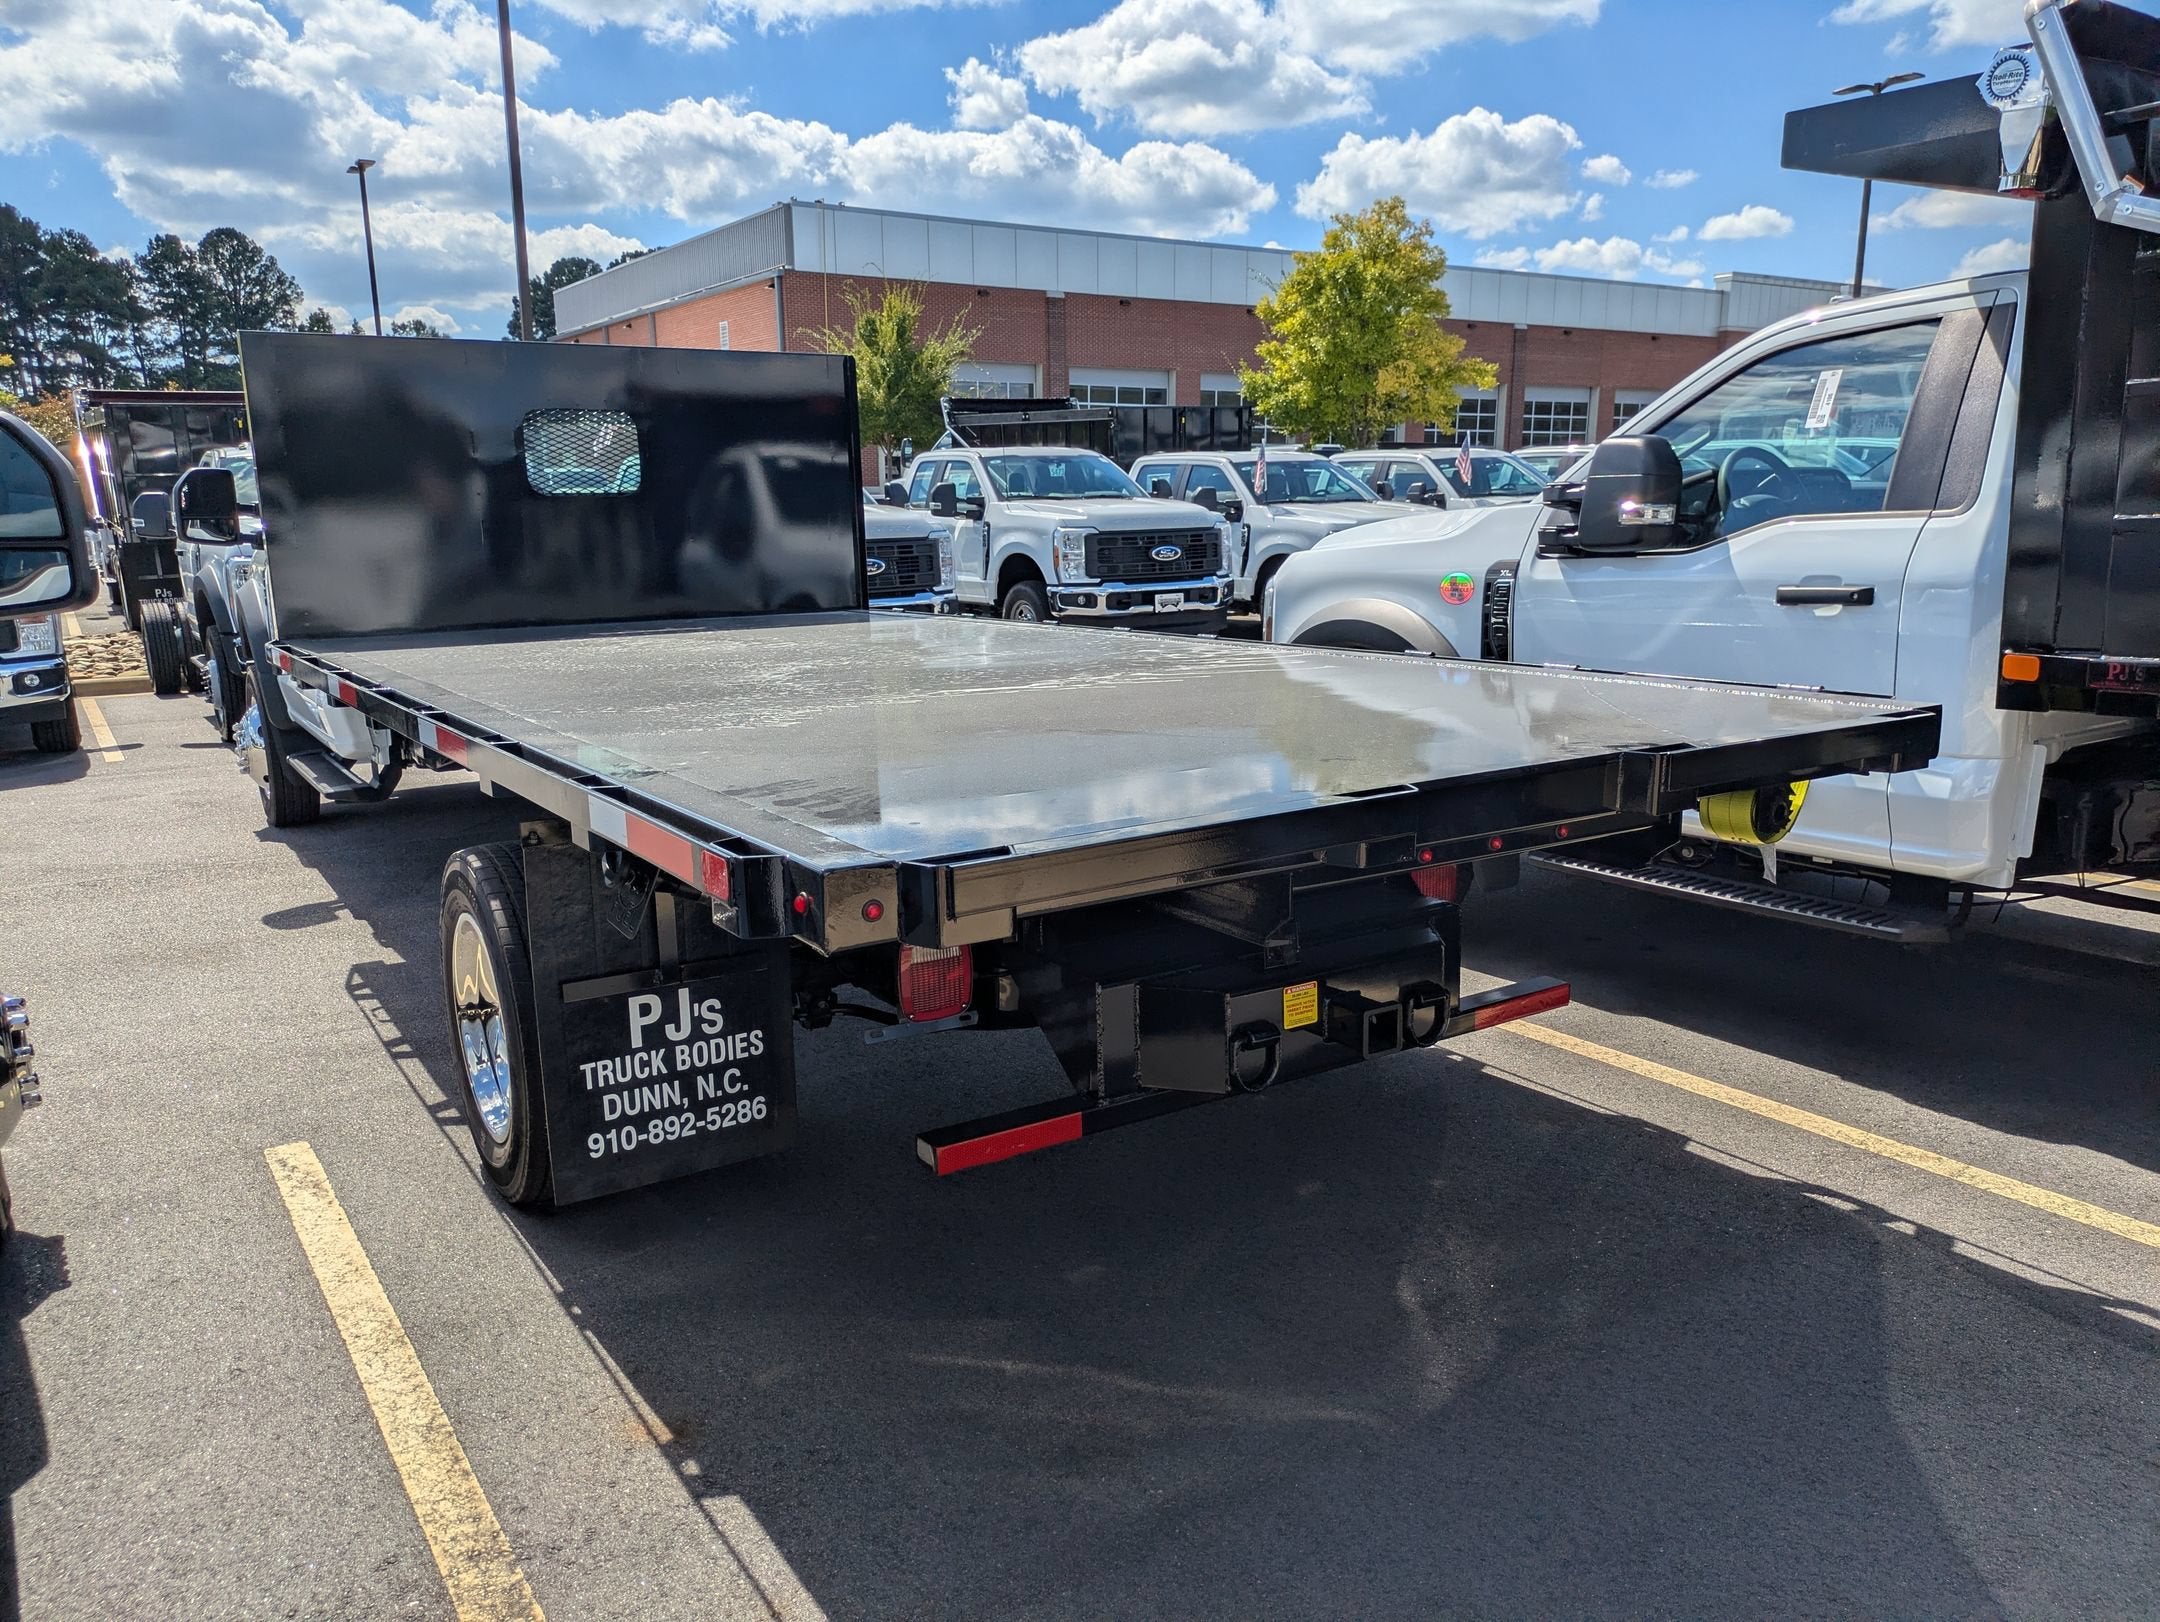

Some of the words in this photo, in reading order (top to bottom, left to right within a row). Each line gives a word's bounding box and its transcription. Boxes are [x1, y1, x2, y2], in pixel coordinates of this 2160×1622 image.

[579, 1048, 668, 1090] TRUCK
[675, 1029, 765, 1071] BODIES
[602, 1080, 689, 1121] DUNN,
[696, 1068, 749, 1101] N.C.
[587, 1095, 767, 1159] 910-892-5286
